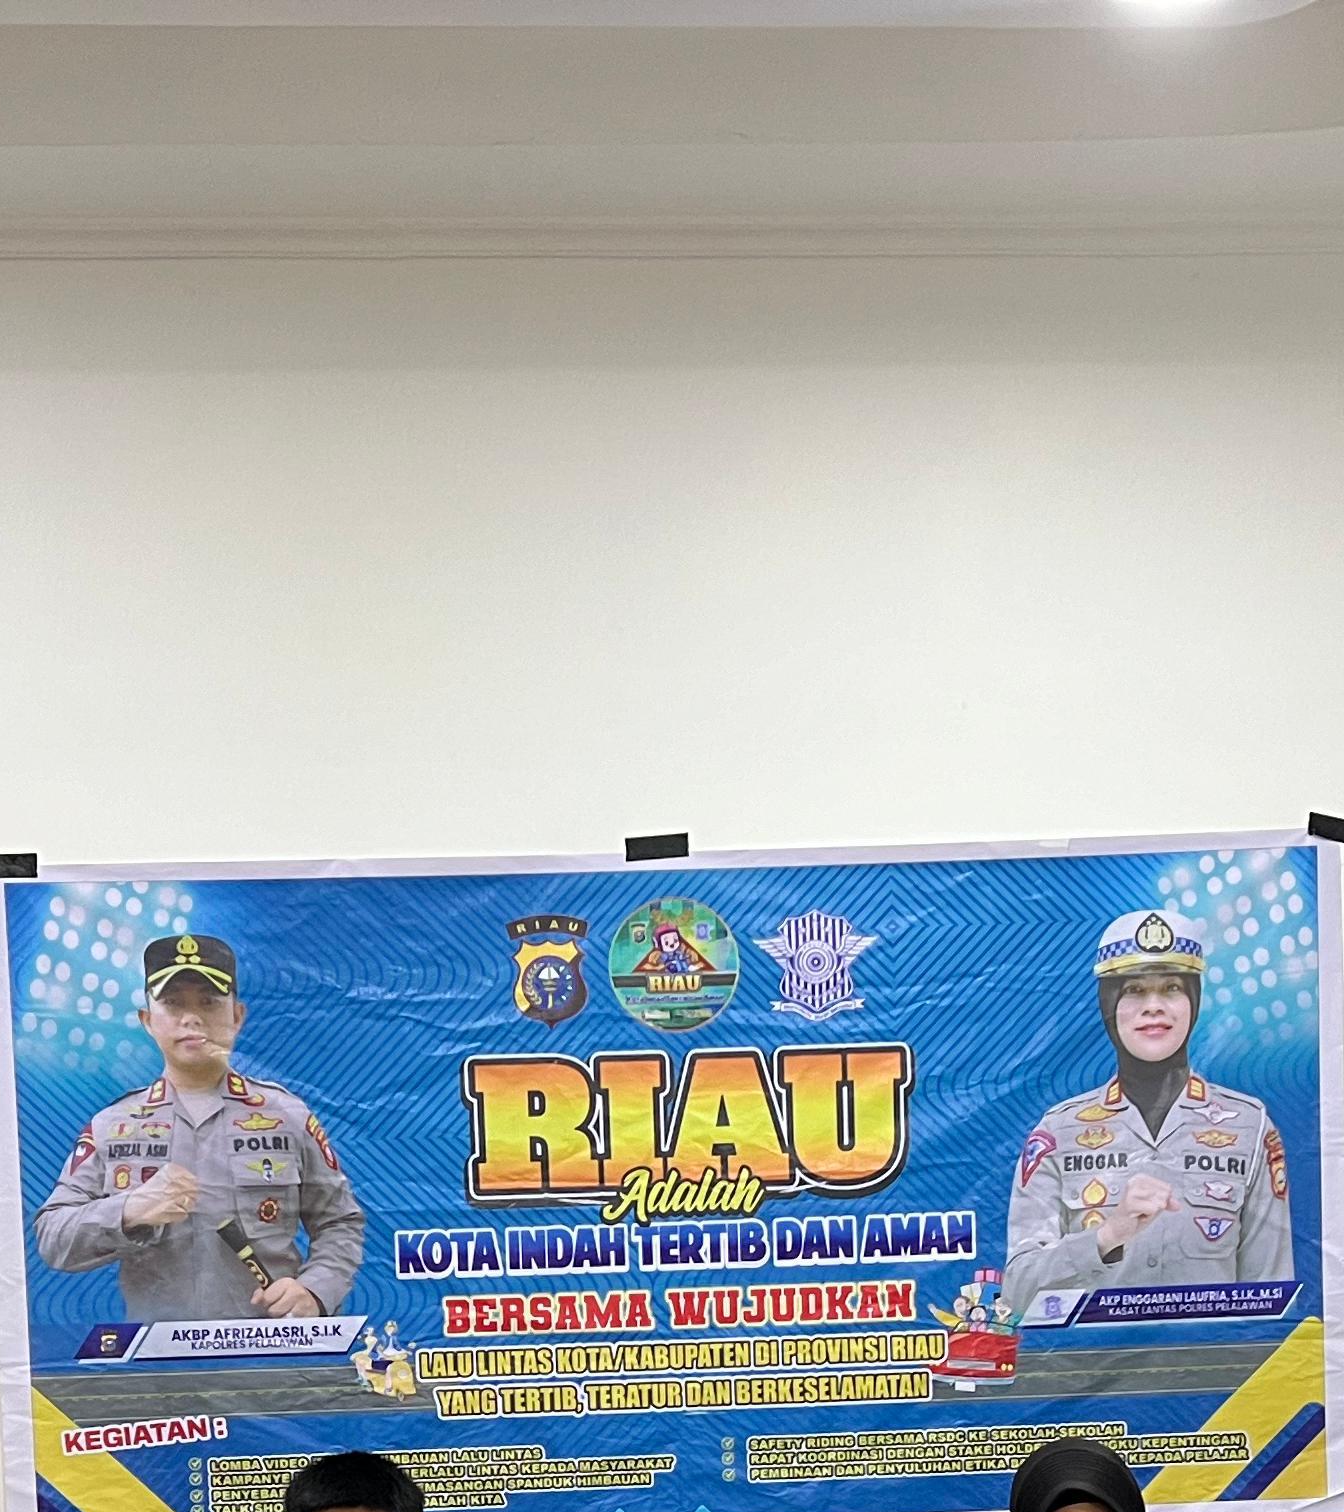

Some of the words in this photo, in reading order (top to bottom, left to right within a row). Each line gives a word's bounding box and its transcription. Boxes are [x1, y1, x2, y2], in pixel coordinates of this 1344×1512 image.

[516, 919, 578, 935] RIAU
[648, 974, 701, 992] RIAU
[468, 1045, 910, 1194] RIAU
[233, 1136, 290, 1152] POLRI
[1063, 1152, 1127, 1172] ENGGAR
[1184, 1154, 1246, 1175] POLRI
[602, 1166, 765, 1221] Adalah
[396, 1230, 498, 1275] KOTA
[508, 1226, 625, 1271] INDAH
[633, 1220, 768, 1266] TERTIB
[776, 1217, 854, 1261] DAN
[861, 1213, 974, 1257] AMAN
[445, 1292, 654, 1335] BERSAMA
[668, 1283, 914, 1327] WUJUDKAN
[1099, 1296, 1120, 1306] AKP
[1178, 1303, 1213, 1313] POLRES
[171, 1329, 209, 1341] AKBP
[191, 1339, 245, 1350] KAPOLRES
[420, 1350, 473, 1379] LALU
[477, 1347, 552, 1376] LINTAS
[556, 1341, 750, 1373] KOTA/KABUPATEN
[753, 1341, 778, 1366] DI
[782, 1337, 887, 1364] PROVINSI
[890, 1334, 945, 1361] RIAU
[437, 1388, 496, 1416] YANG
[500, 1385, 584, 1414] TERTIB,
[585, 1381, 683, 1409] TERATUR
[685, 1379, 732, 1405] DAN
[735, 1373, 929, 1405] BERKESELAMATAN
[63, 1418, 207, 1453] KEGIATAN
[750, 1438, 803, 1450] SAFETY
[807, 1436, 854, 1448] RIDING
[858, 1433, 924, 1446] BERSAMA
[927, 1431, 965, 1443] RSDC
[968, 1430, 988, 1441] KE
[1141, 1434, 1245, 1449] KEPENTINGAN)
[452, 1451, 488, 1463] LALU
[492, 1448, 542, 1461] LINTAS
[750, 1453, 796, 1465] RAPAT
[798, 1450, 883, 1463] KOORDINASI
[886, 1447, 944, 1459] DENGAN
[948, 1445, 994, 1457] STAKE
[996, 1443, 1047, 1456] HOLDE
[1128, 1451, 1184, 1464] KEPADA
[1186, 1449, 1249, 1462] PELAJAR
[211, 1459, 260, 1471] LOMBA
[265, 1457, 309, 1470] VIDEO
[468, 1464, 517, 1476] LINTAS
[521, 1462, 576, 1474] KEPADA
[579, 1457, 674, 1472] MASYARAKAT
[751, 1467, 832, 1480] PEMBINAAN
[836, 1464, 864, 1476] DAN
[868, 1462, 962, 1475] PENYULUHAN
[965, 1460, 1006, 1472] ETIKA
[211, 1472, 290, 1486] KAMPANYE
[507, 1477, 574, 1490] SPANDUK
[576, 1474, 650, 1487] HIMBAUAN
[423, 1495, 466, 1507] DALAH
[469, 1493, 505, 1505] KITA
